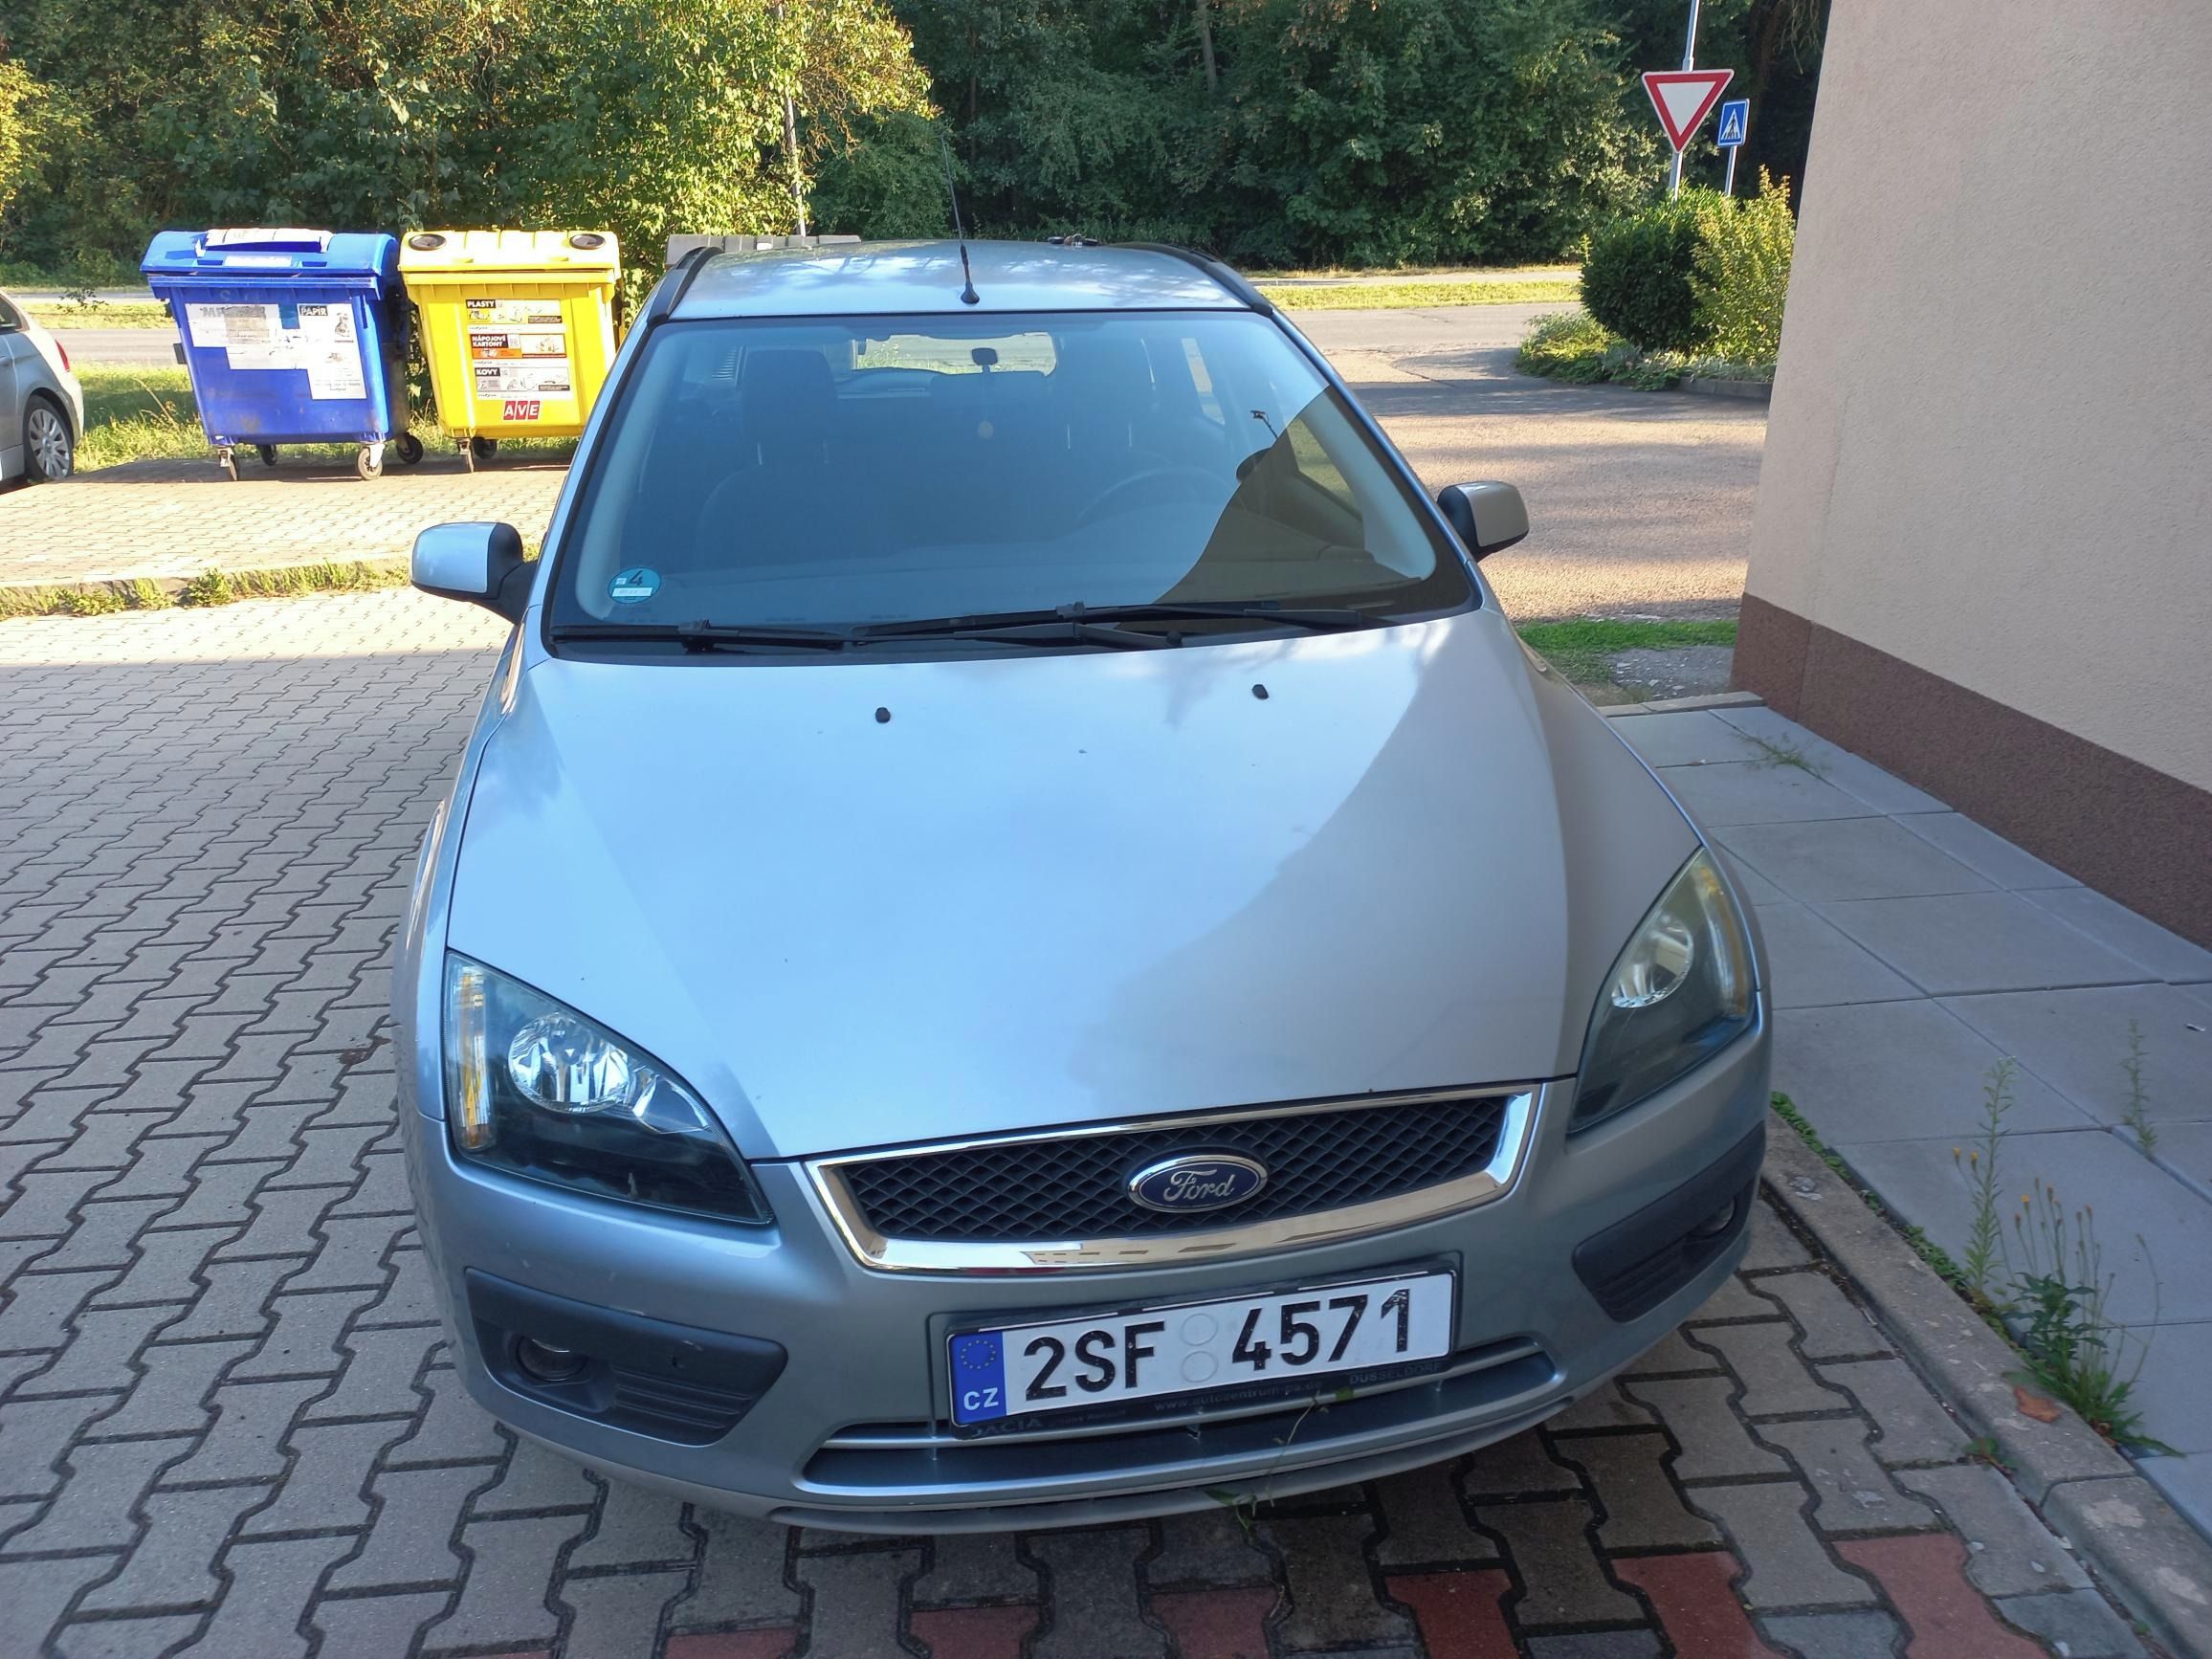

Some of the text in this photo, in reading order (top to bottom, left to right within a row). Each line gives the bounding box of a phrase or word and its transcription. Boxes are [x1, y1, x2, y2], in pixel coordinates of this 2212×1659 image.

[300, 306, 327, 316] PAPÍR
[504, 403, 539, 419] AVE
[629, 570, 643, 586] 4
[1163, 1169, 1235, 1202] Ford
[1023, 1288, 1411, 1401] 2SF 4571
[963, 1387, 999, 1410] CZ
